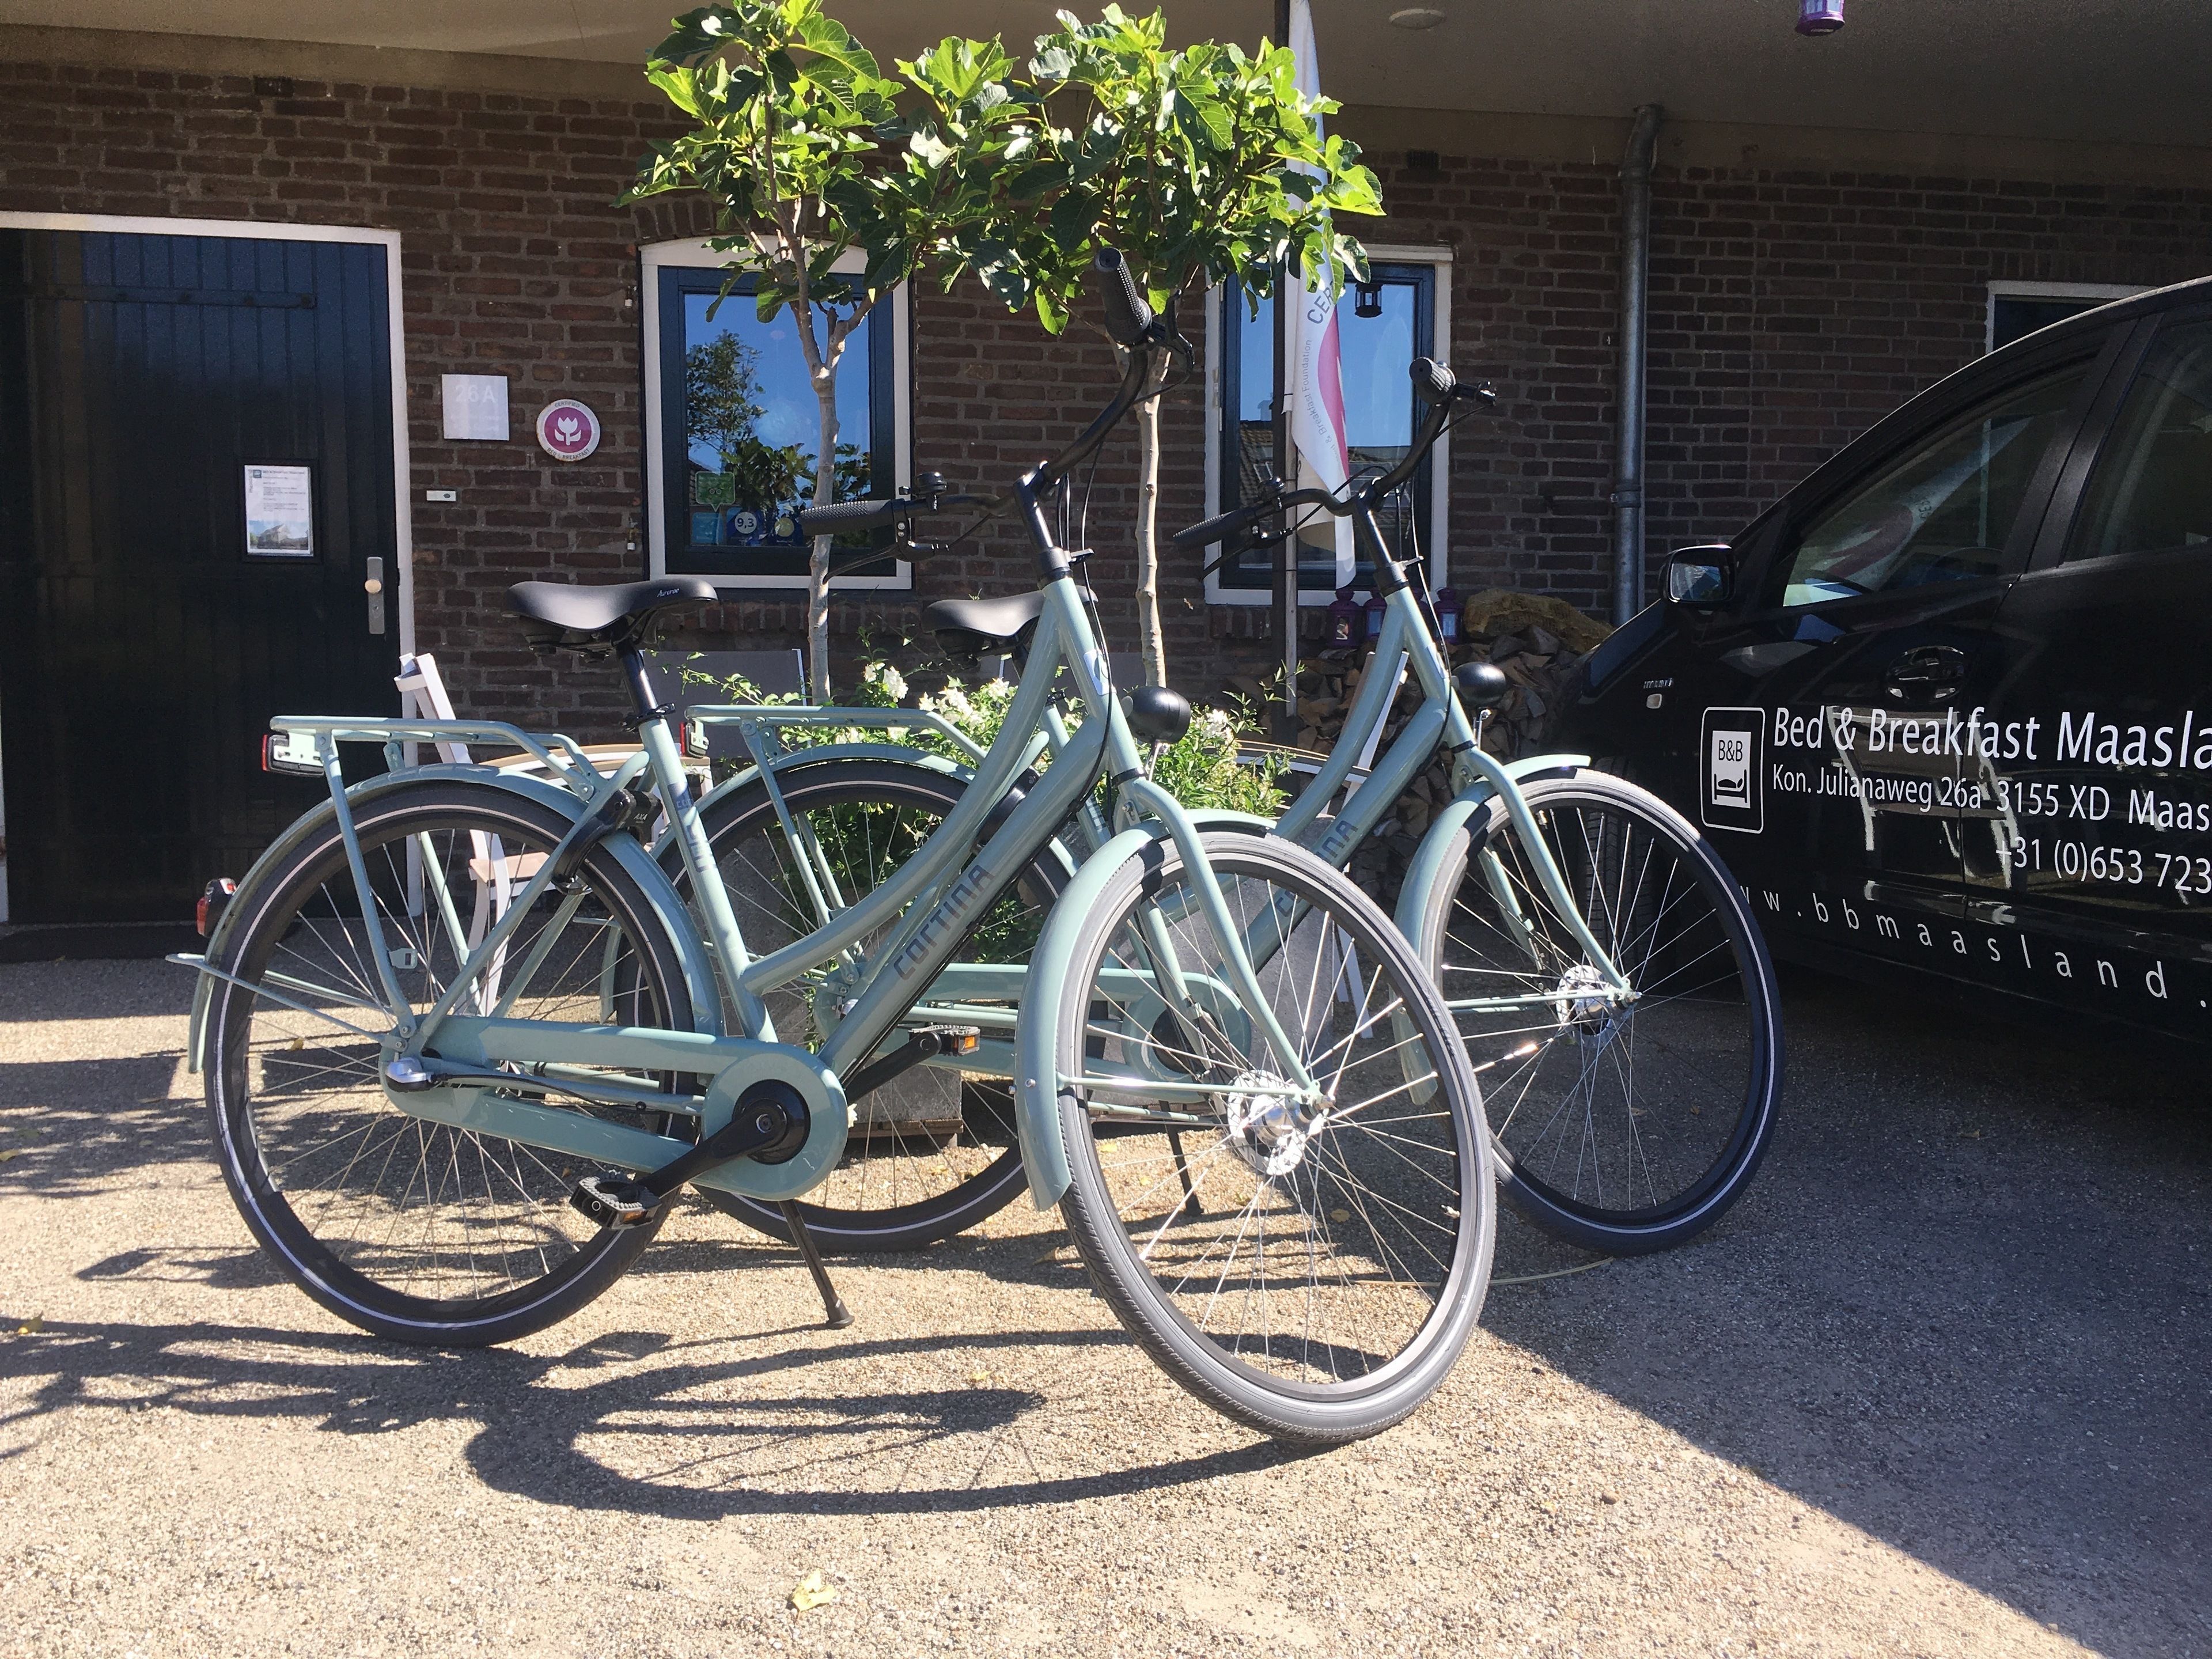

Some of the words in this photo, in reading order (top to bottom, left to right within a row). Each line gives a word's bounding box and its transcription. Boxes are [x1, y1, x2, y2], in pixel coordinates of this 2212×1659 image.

[1307, 281, 1334, 324] CER
[1302, 339, 1312, 392] Foundation
[455, 384, 496, 403] 26A
[1305, 393, 1327, 435] Breakfast
[547, 447, 557, 456] BED
[562, 448, 590, 459] BREAKFAST
[737, 518, 754, 528] 9,3
[1718, 740, 1743, 762] B&B
[1774, 705, 1825, 748] Bed
[1835, 707, 1857, 751] &
[1869, 706, 2040, 761] Breakfast
[1773, 764, 1812, 794] Kon.
[1816, 767, 1932, 812] Julianaweg
[1940, 776, 1981, 809] 26a
[1997, 780, 2059, 816] 3155
[2069, 784, 2110, 821] XD
[2128, 789, 2210, 831] Maas
[1995, 836, 2041, 870] +31
[2054, 839, 2143, 884] (0)653
[2155, 853, 2212, 894] 723
